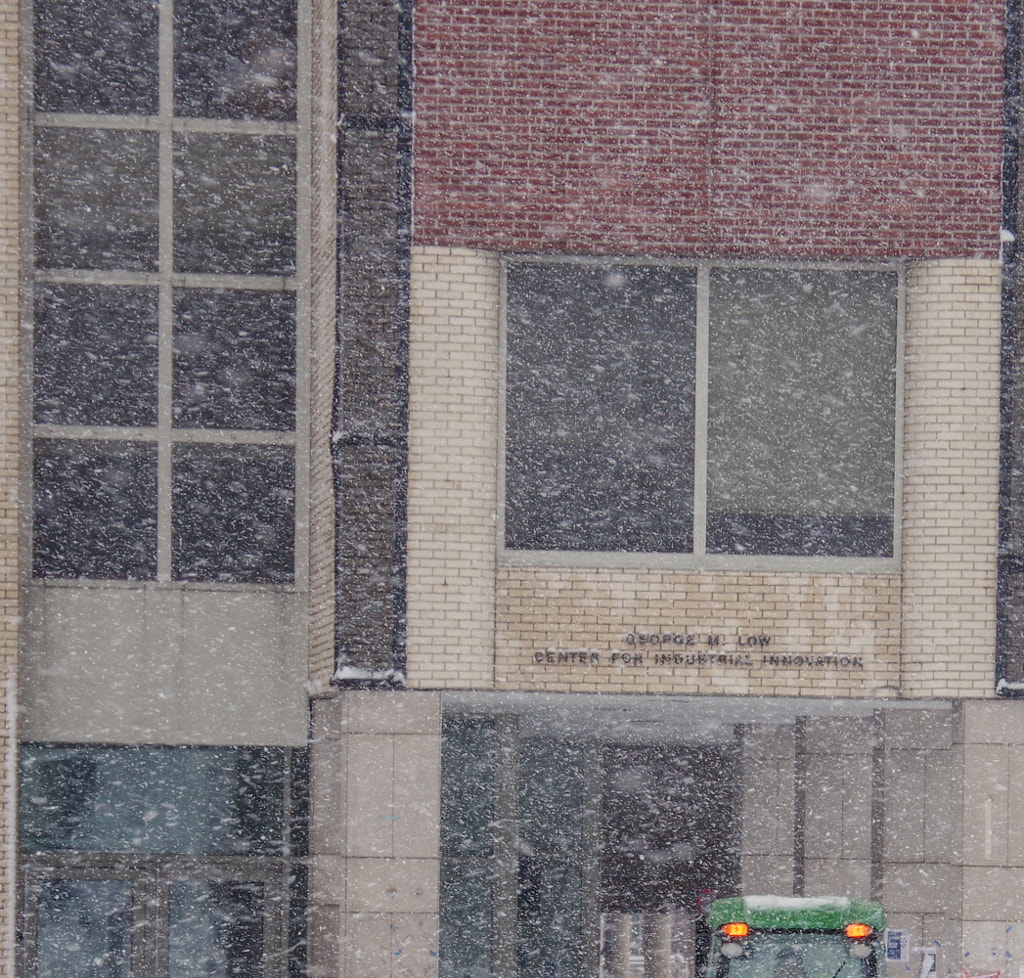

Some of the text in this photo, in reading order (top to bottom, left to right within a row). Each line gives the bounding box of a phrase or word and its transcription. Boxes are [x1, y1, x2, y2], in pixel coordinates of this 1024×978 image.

[626, 633, 696, 646] GEORGE
[738, 634, 772, 647] LOW
[534, 651, 864, 669] CENTER FOR INDUSTRIAL INNOVATION
